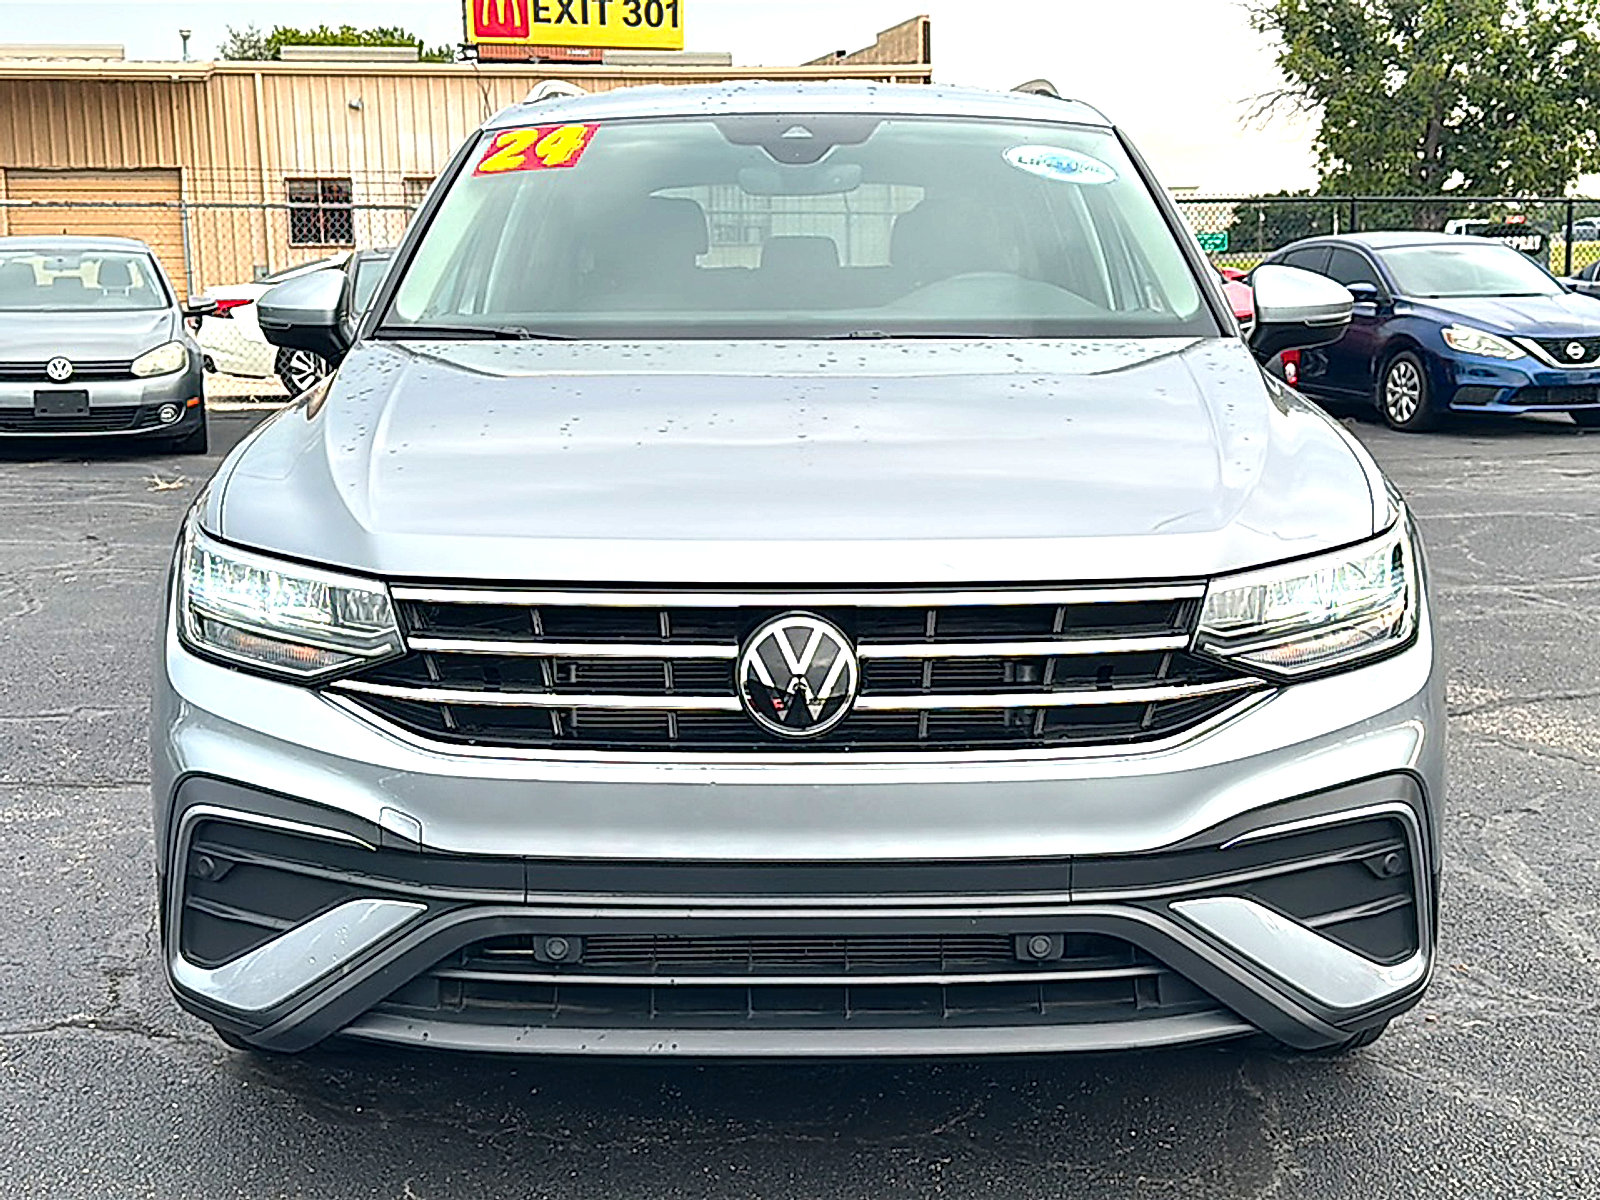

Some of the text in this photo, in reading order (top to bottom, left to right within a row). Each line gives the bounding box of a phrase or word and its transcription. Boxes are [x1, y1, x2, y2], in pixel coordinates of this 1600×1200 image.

[533, 0, 679, 28] EXIT 301
[478, 124, 589, 172] 24
